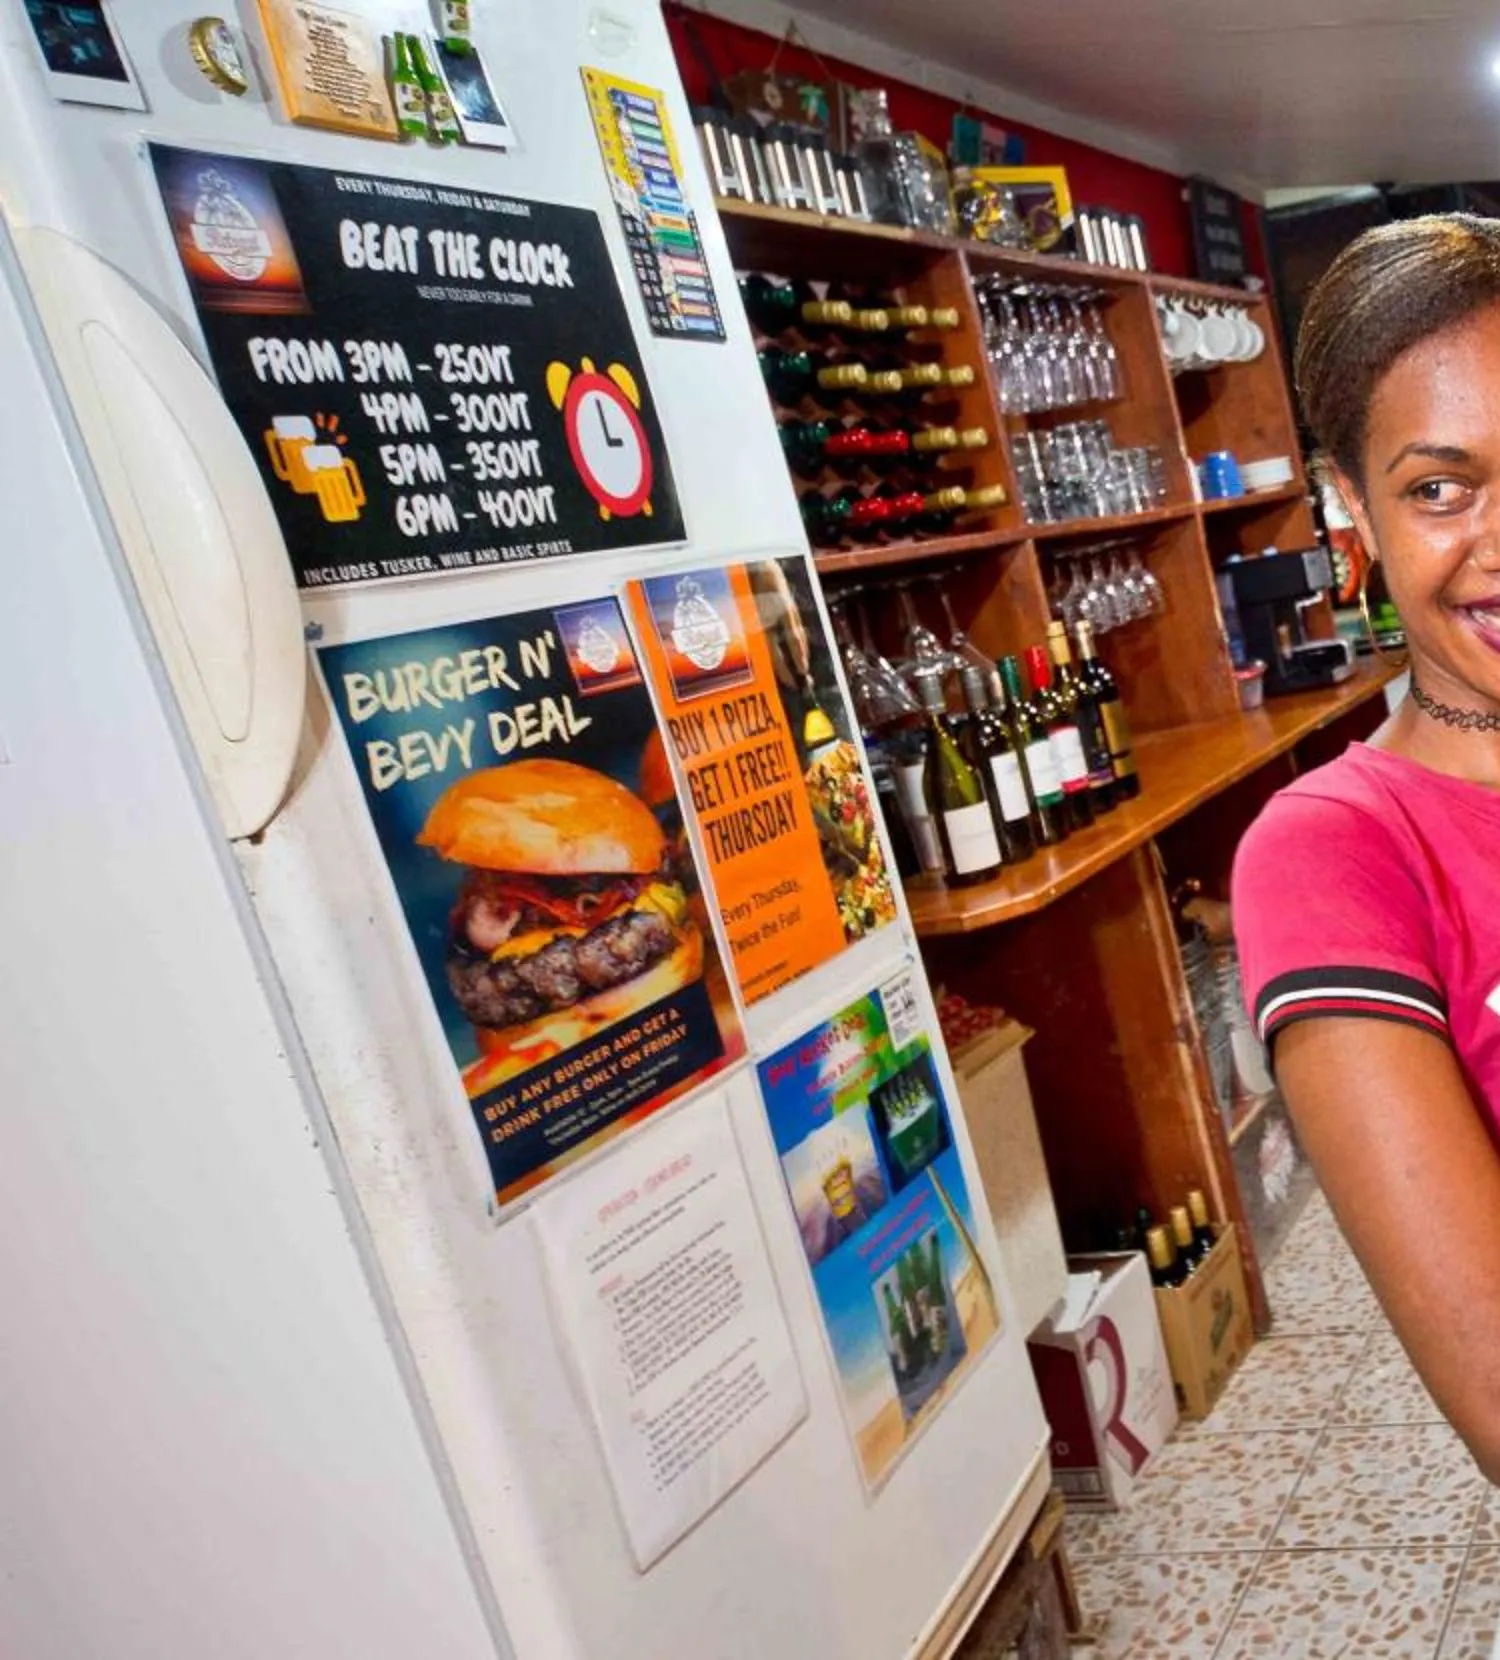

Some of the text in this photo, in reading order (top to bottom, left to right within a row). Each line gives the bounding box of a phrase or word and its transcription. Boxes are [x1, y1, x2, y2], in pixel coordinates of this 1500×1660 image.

[335, 176, 376, 195] EVERY
[339, 218, 575, 289] BEAT THE CLOCK
[248, 336, 345, 385] FROM
[343, 340, 414, 384] 3PM
[434, 343, 515, 385] 250VT
[360, 391, 430, 435] 4PM
[450, 392, 532, 433] 300VT
[379, 442, 447, 486] 5PM
[465, 439, 544, 482] 350VT
[396, 493, 459, 537] 6PM
[477, 485, 557, 529] 400VT
[304, 563, 380, 585] INCLUDES
[439, 550, 474, 569] WINE
[475, 547, 500, 565] AND
[501, 543, 535, 562] BASIC
[343, 645, 521, 725] BURGER
[518, 629, 557, 680] N'
[365, 694, 593, 792] BEVY DEAL
[668, 691, 782, 761] BUY 1 PIZZA,
[687, 738, 792, 814] GET 1 FREE!!
[704, 790, 798, 865] THURSDAY
[720, 901, 752, 927] Every
[728, 931, 760, 956] Twice
[760, 920, 779, 940] the
[483, 1007, 681, 1122] BUY ANY BURGER AND GET A
[491, 1106, 542, 1144] DRINK
[542, 1084, 582, 1114] FREE
[581, 1063, 620, 1092] ONLY
[619, 1050, 642, 1070] ON
[641, 1023, 689, 1058] FRIDAY
